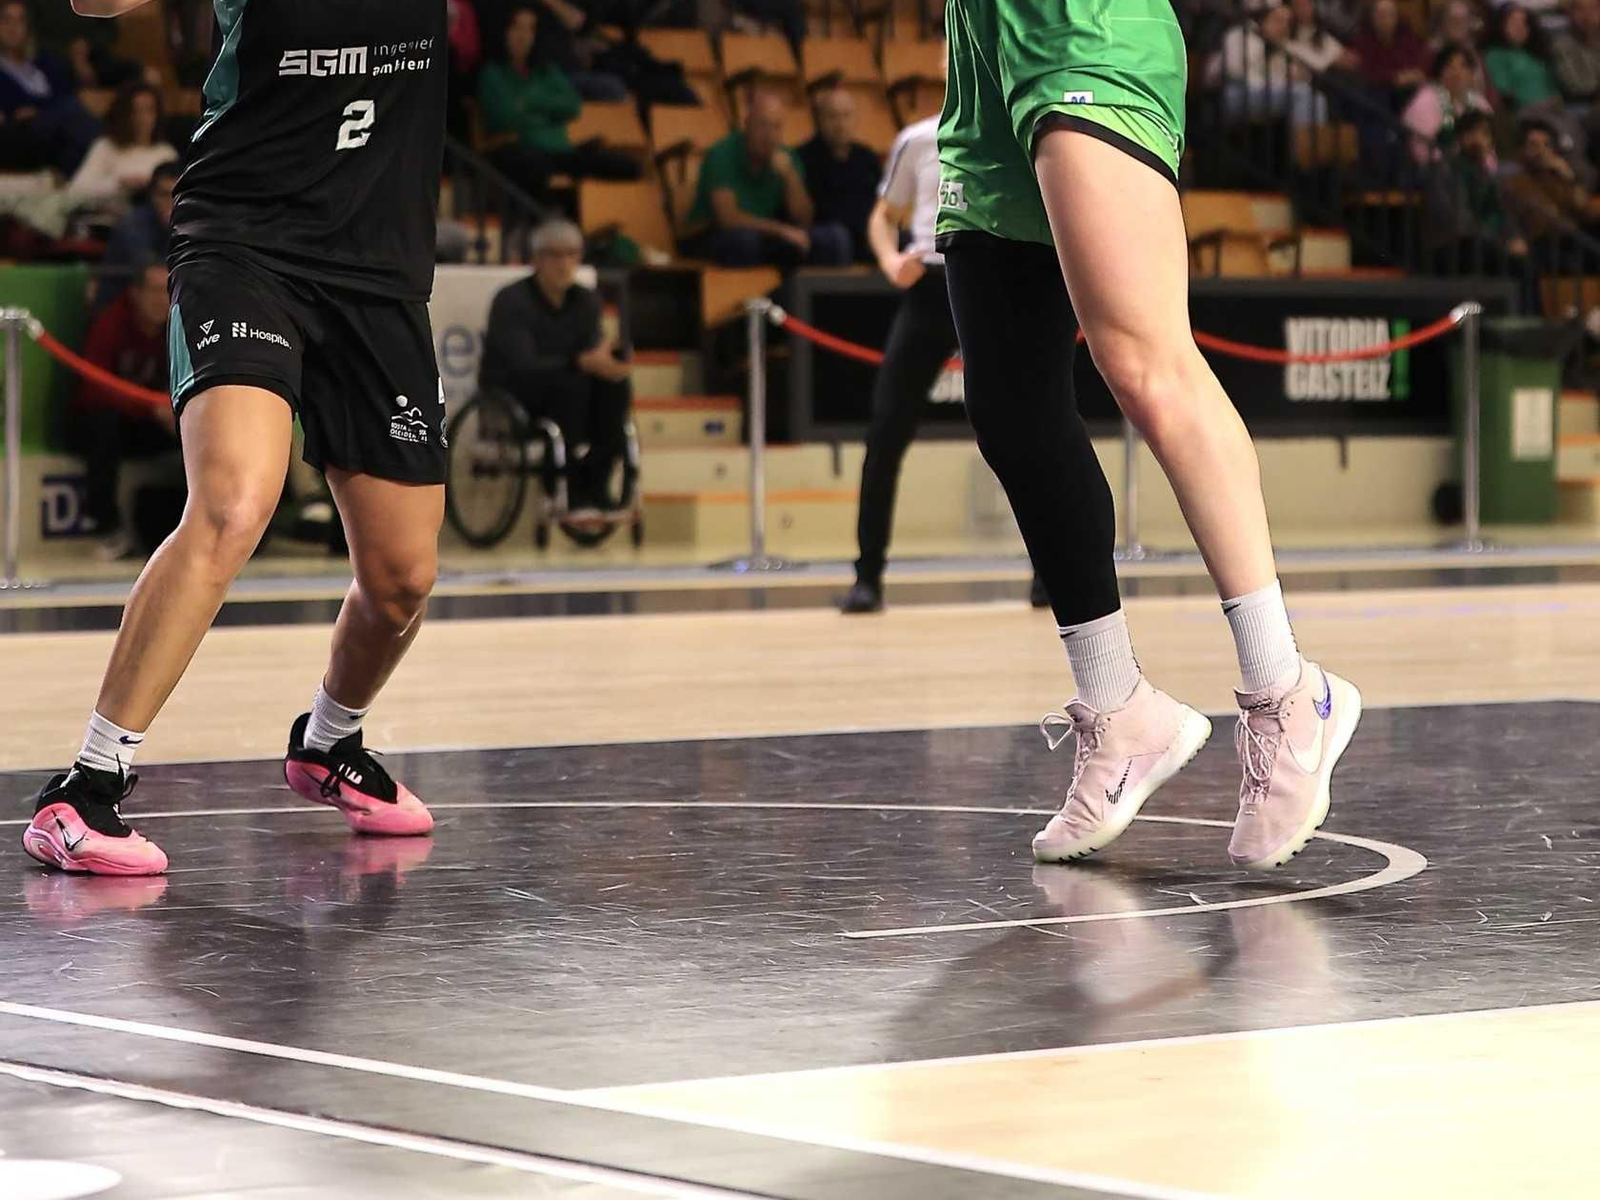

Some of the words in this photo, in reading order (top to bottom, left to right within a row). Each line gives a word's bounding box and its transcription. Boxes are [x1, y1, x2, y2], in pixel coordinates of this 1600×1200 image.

[278, 46, 368, 77] SGM
[335, 99, 376, 151] 2
[196, 333, 221, 350] vive
